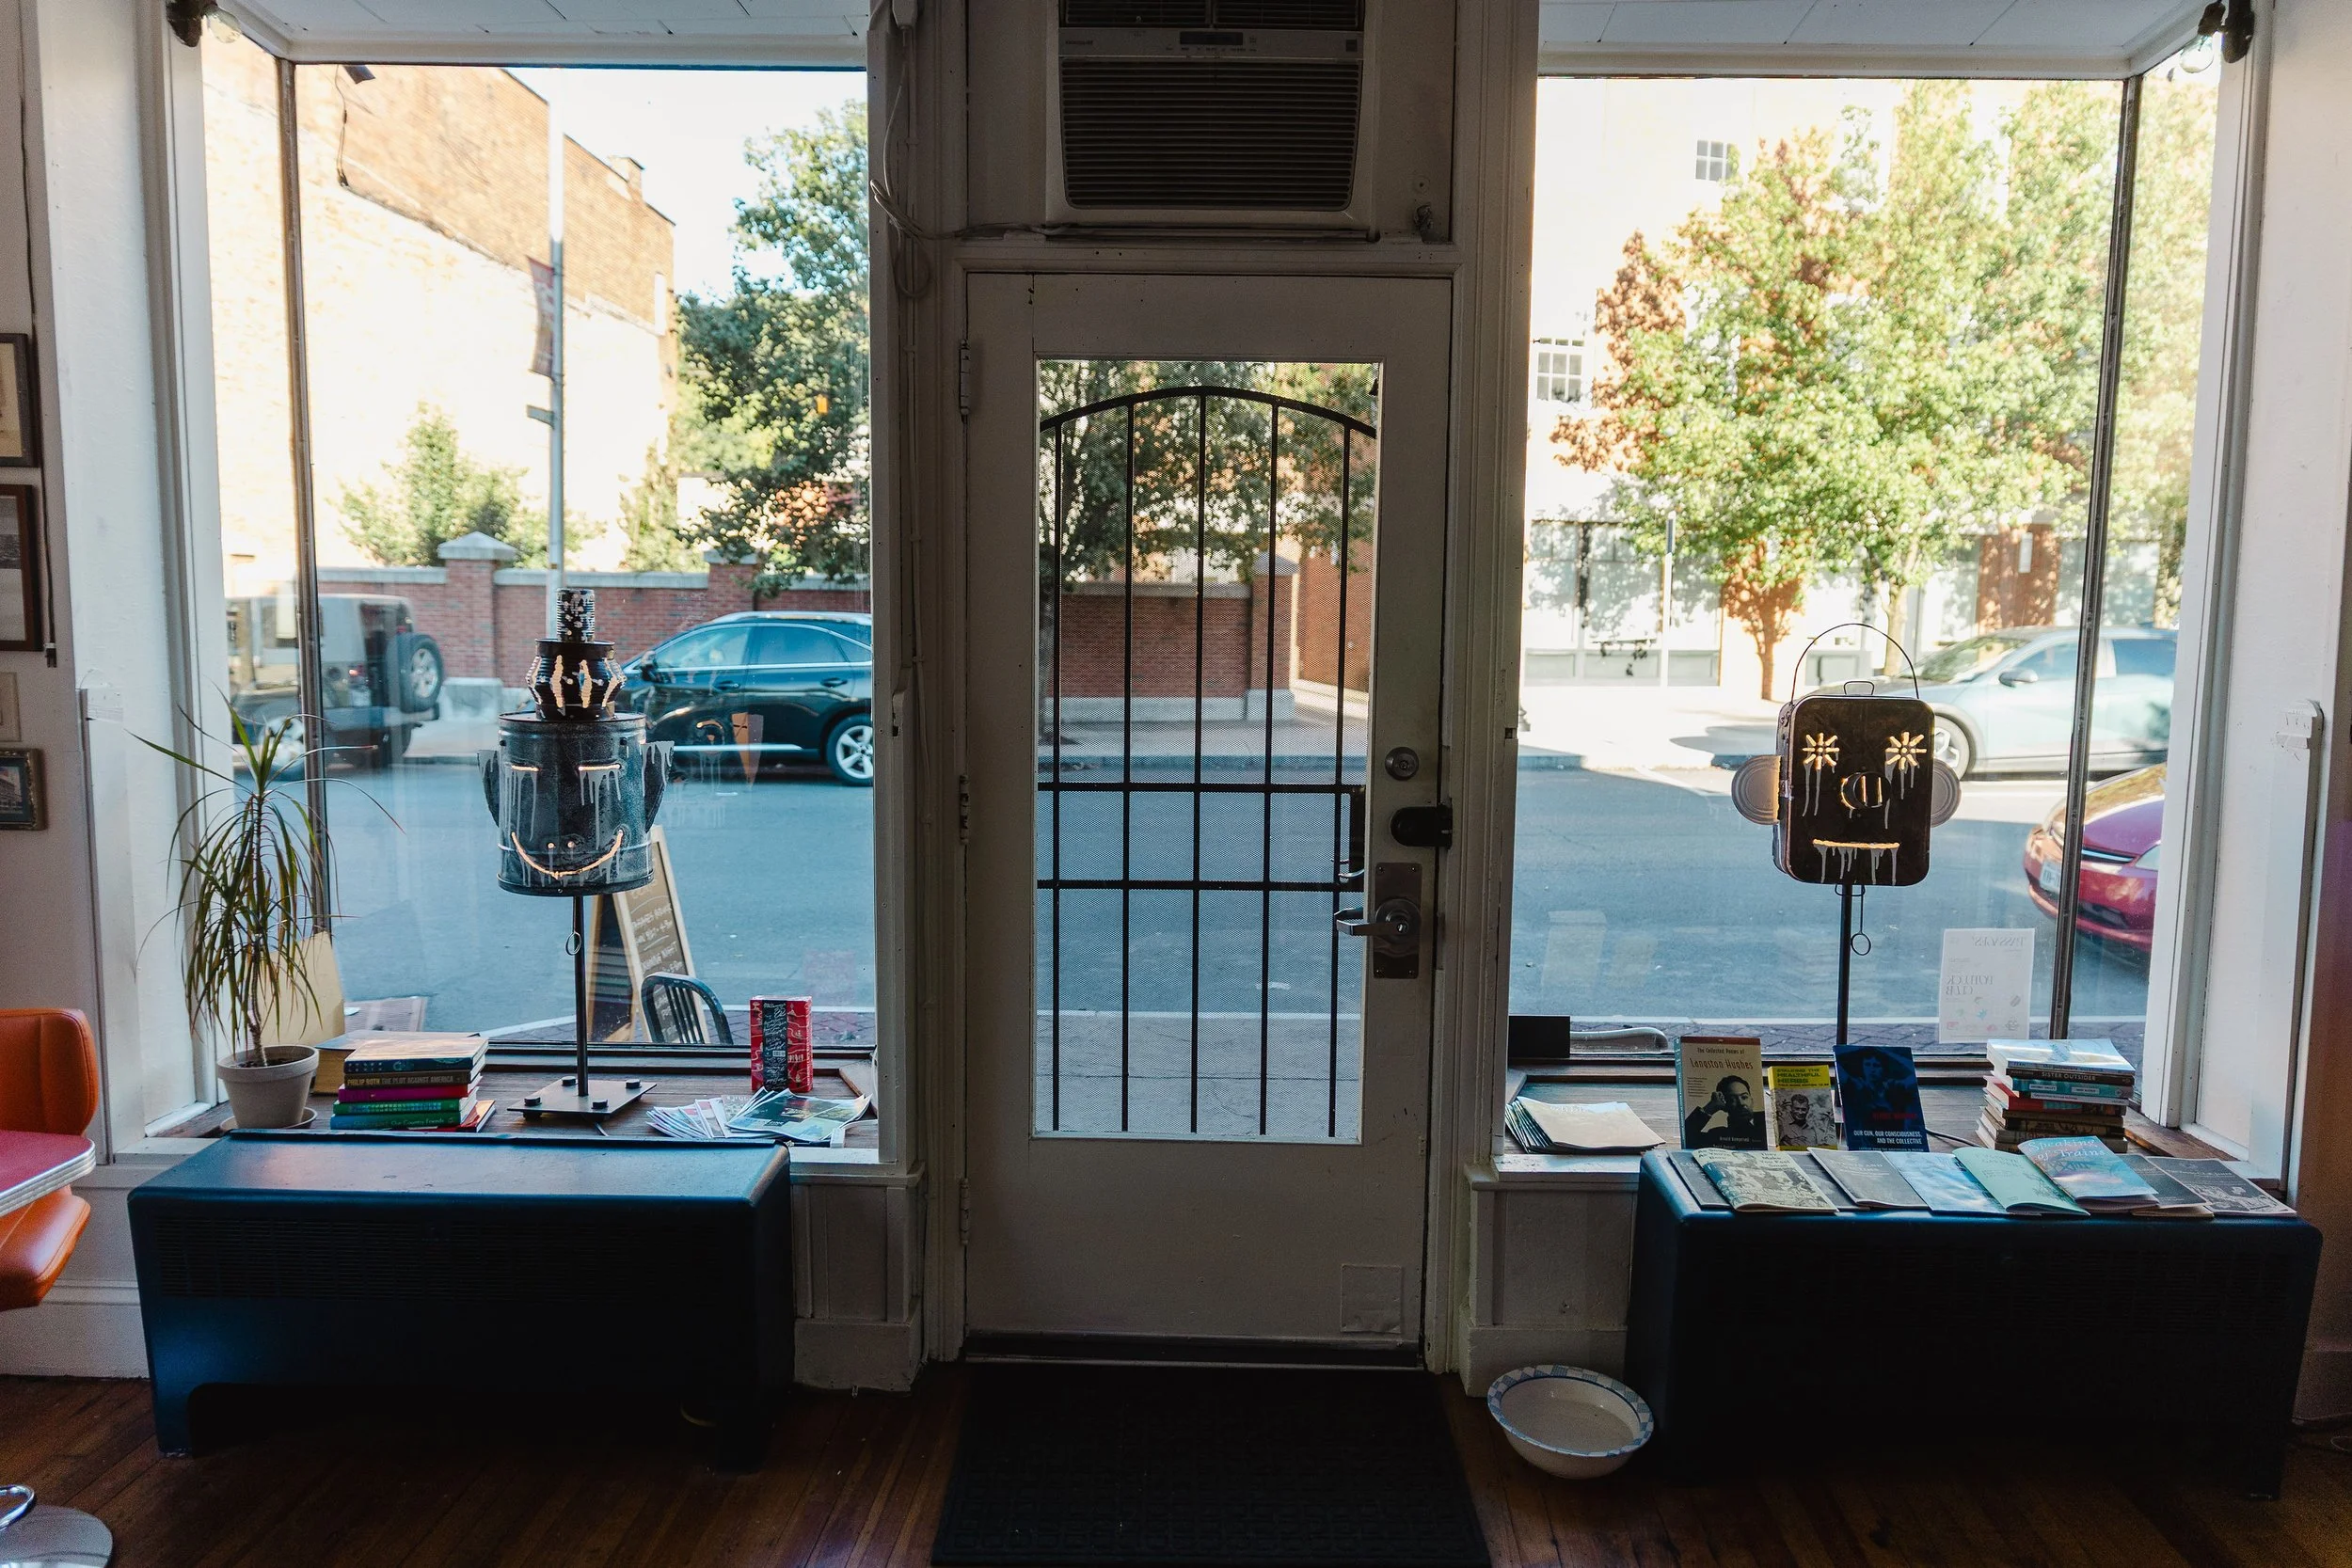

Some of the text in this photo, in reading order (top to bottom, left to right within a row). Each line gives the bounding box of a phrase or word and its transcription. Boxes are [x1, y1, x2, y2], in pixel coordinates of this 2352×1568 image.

[1689, 1057, 1754, 1069] Langston Hughes
[406, 1075, 430, 1084] AGAINST
[2063, 1073, 2096, 1082] OUTSIDER
[2027, 1139, 2098, 1152] Speaking
[2036, 1149, 2106, 1161] of Trains
